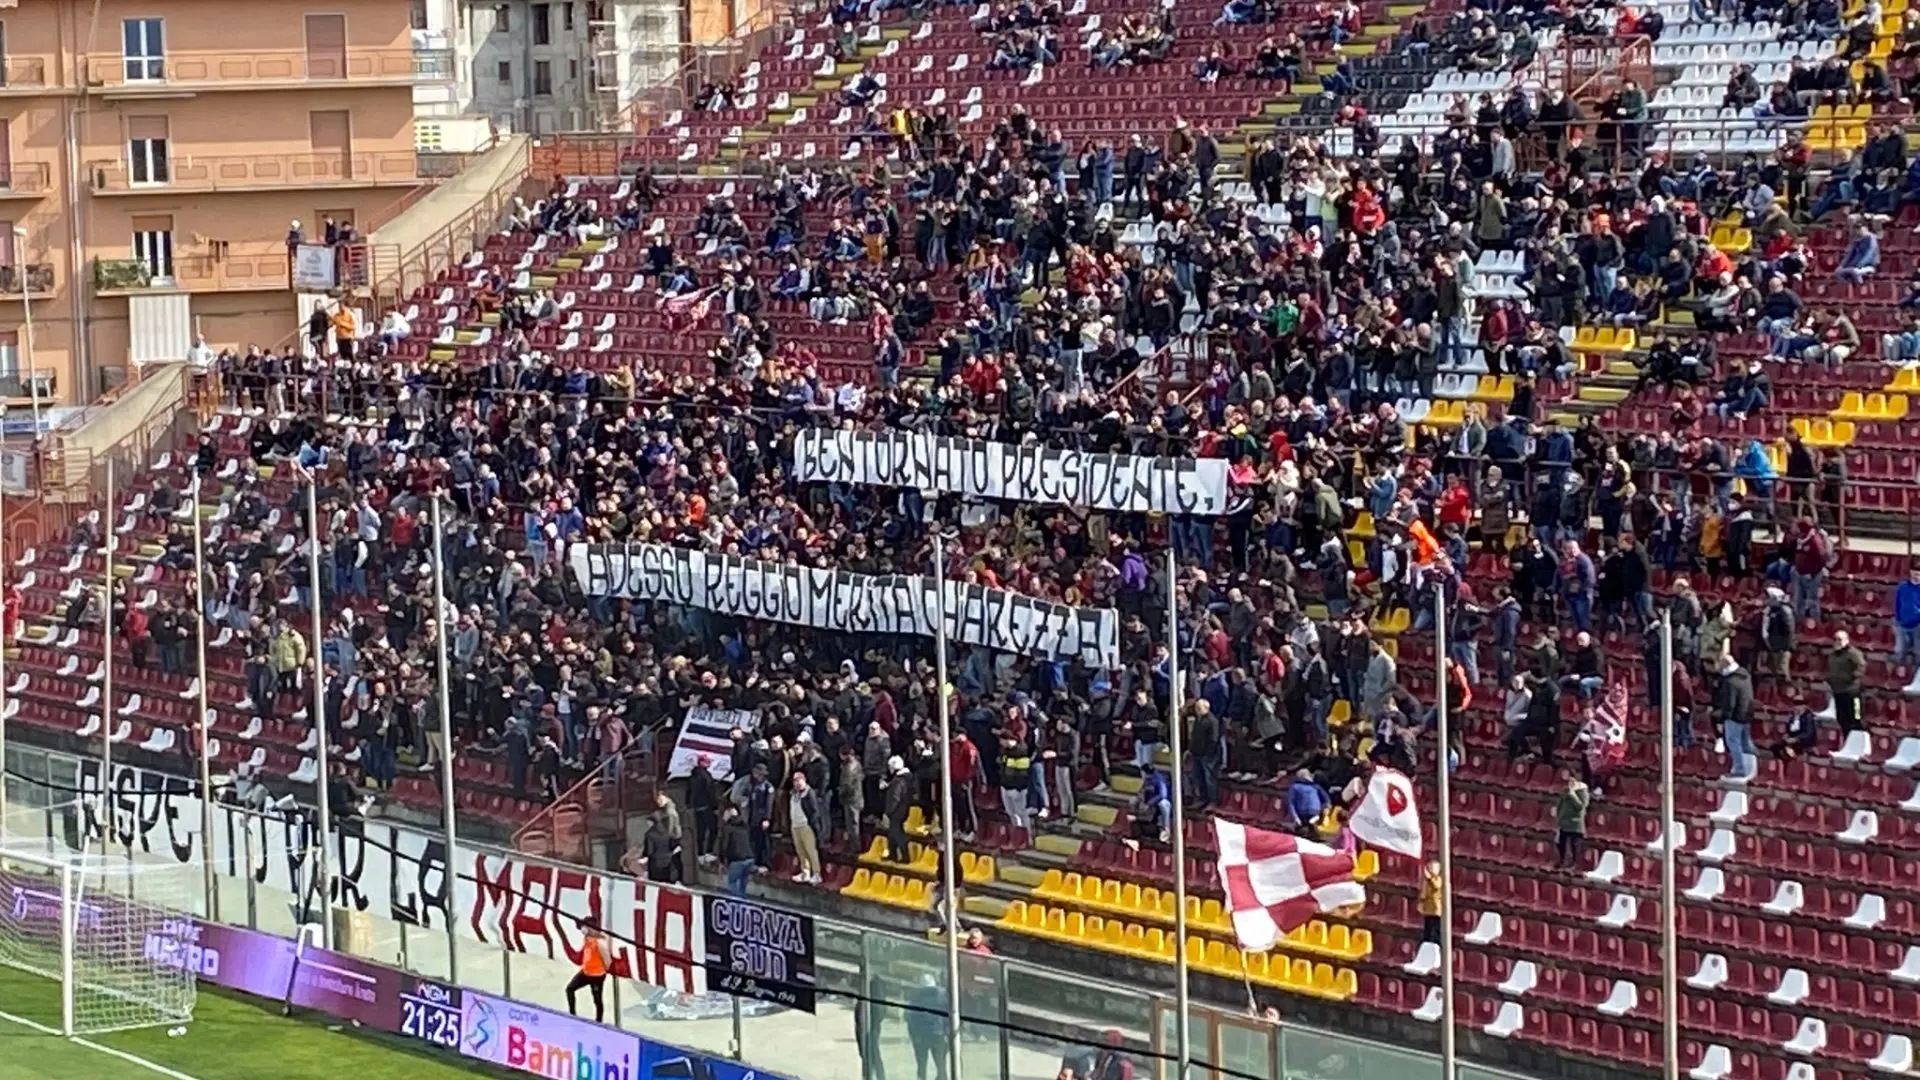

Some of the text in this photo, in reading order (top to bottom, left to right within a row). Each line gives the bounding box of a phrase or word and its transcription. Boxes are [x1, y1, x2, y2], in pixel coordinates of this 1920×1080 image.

[804, 429, 989, 493] BENTORNATO
[587, 542, 692, 602] ADESSO
[705, 552, 801, 621] REGGIO
[810, 568, 916, 633] MERITA
[81, 759, 268, 884] RISPETO
[390, 826, 451, 931] LA
[711, 899, 805, 955] CURVA
[730, 940, 788, 982] SUD
[402, 1001, 460, 1048] 21:25
[508, 1024, 630, 1080] Bambini
